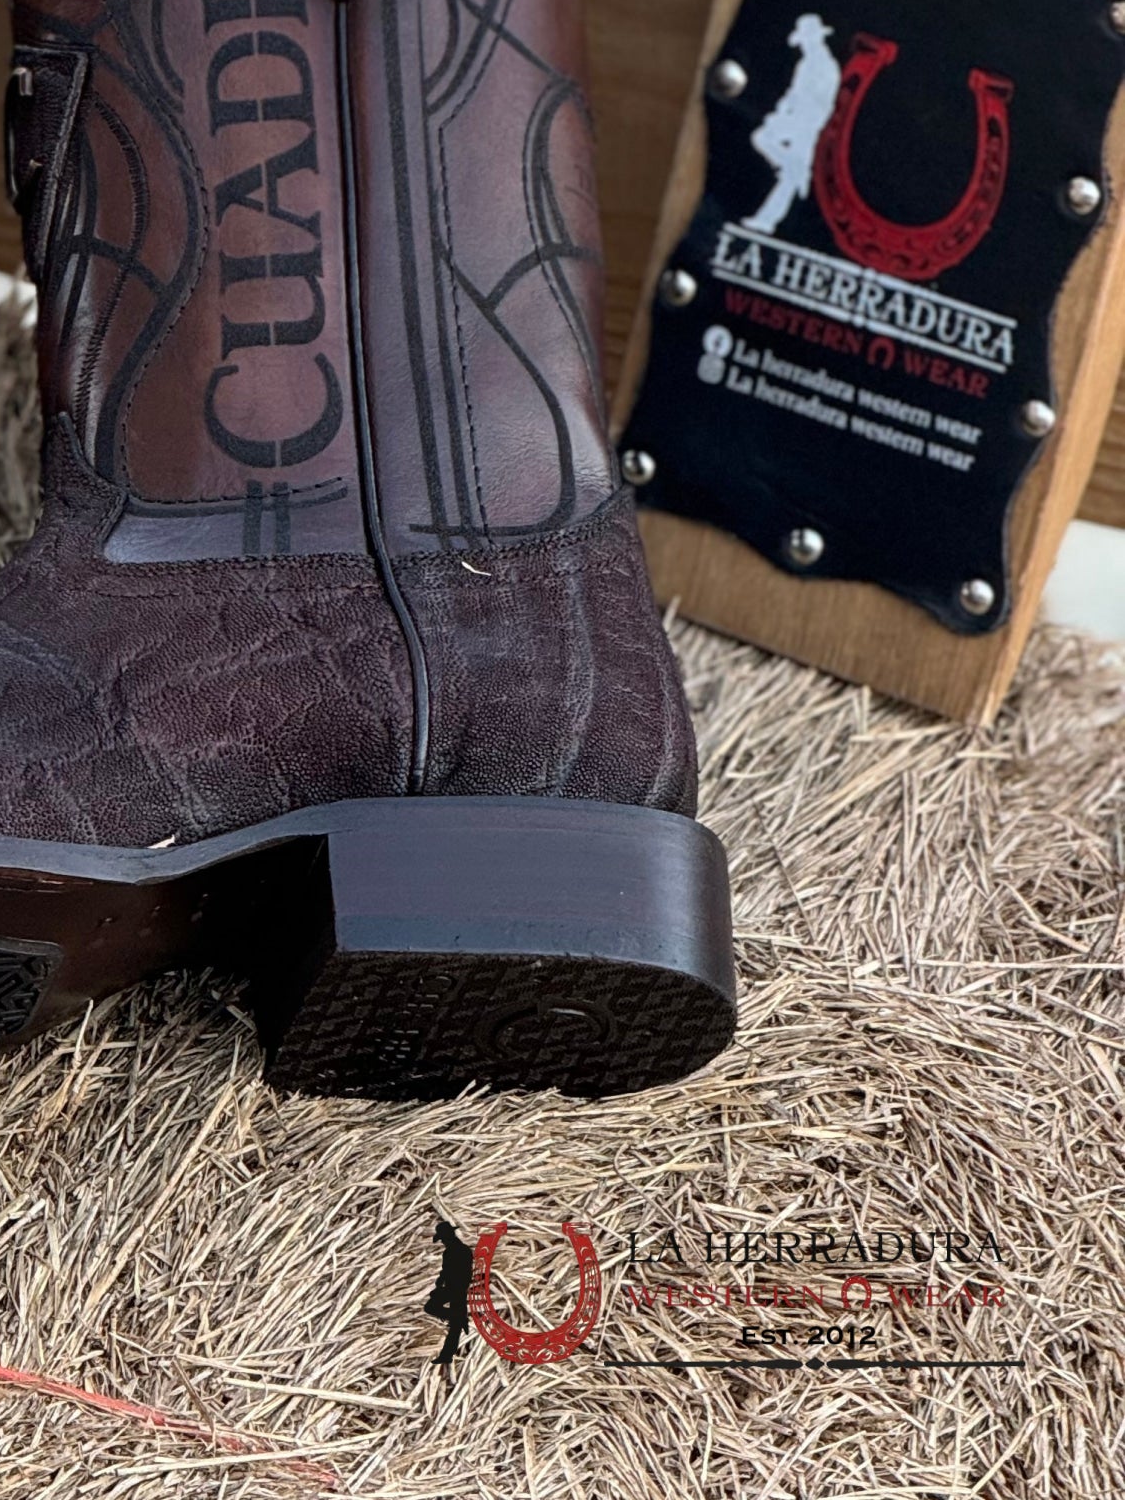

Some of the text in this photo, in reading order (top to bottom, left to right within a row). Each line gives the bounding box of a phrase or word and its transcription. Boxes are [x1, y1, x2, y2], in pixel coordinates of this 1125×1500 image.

[709, 231, 1013, 365] LA HERRADURA
[725, 287, 990, 399] WESTERN WEAR
[726, 366, 975, 472] La herradura western wear
[732, 338, 982, 444] La herradura western wear
